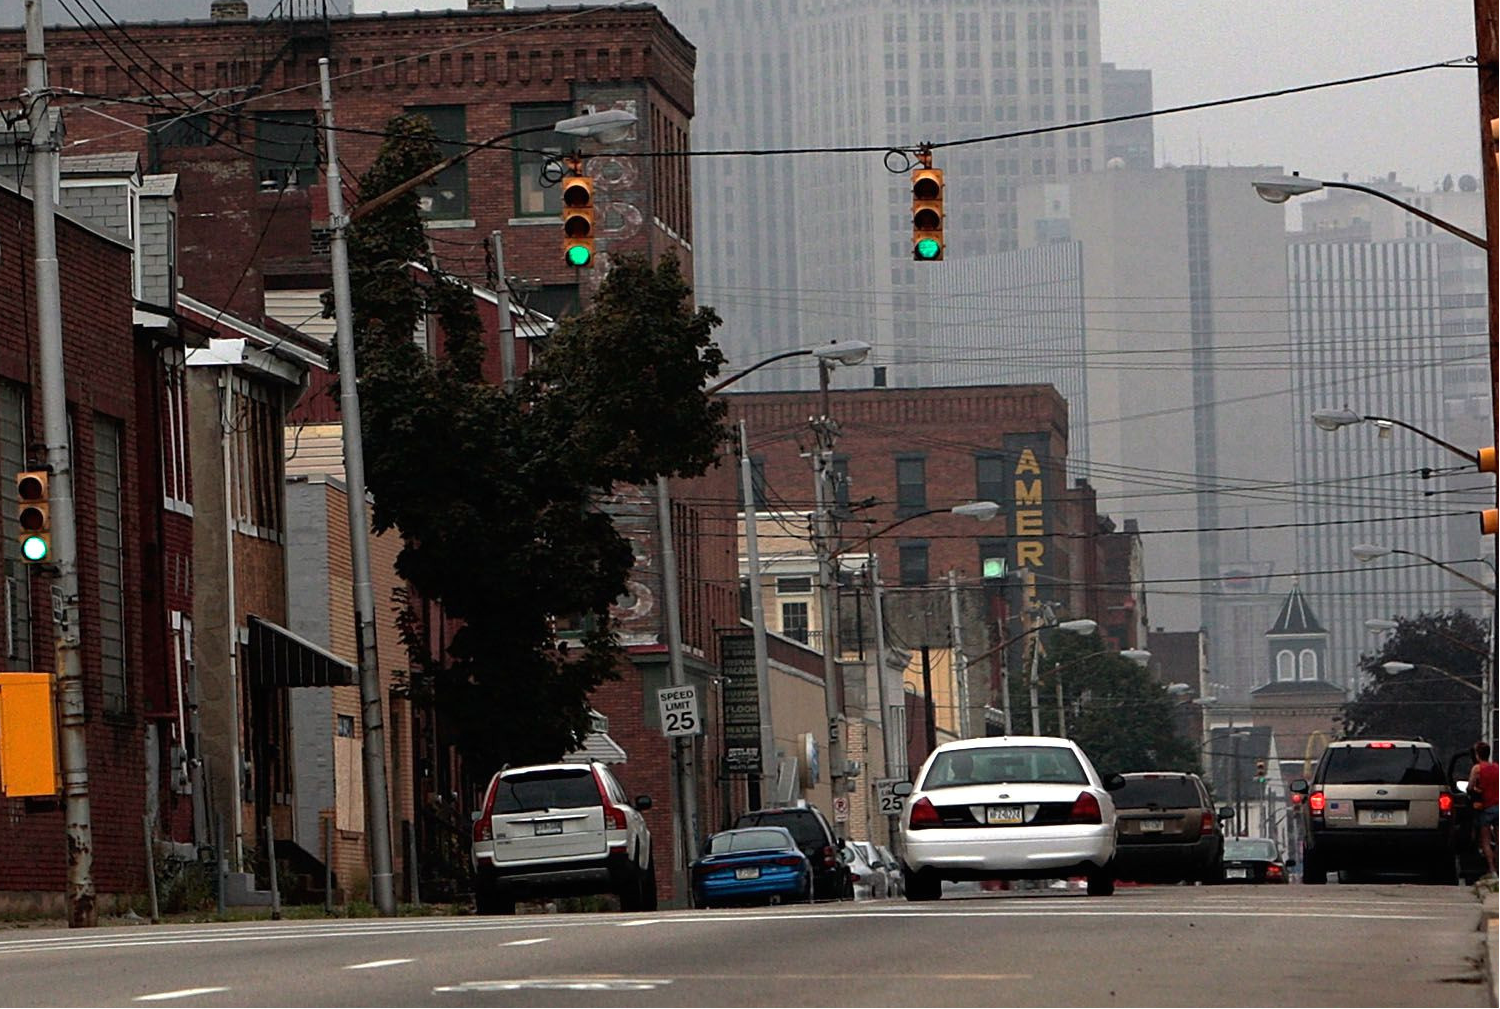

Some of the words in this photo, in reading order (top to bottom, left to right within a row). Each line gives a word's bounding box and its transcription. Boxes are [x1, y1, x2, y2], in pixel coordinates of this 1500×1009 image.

[660, 690, 694, 702] SPEED
[665, 701, 691, 711] LIMIT
[666, 711, 695, 731] 25
[882, 797, 903, 811] 25
